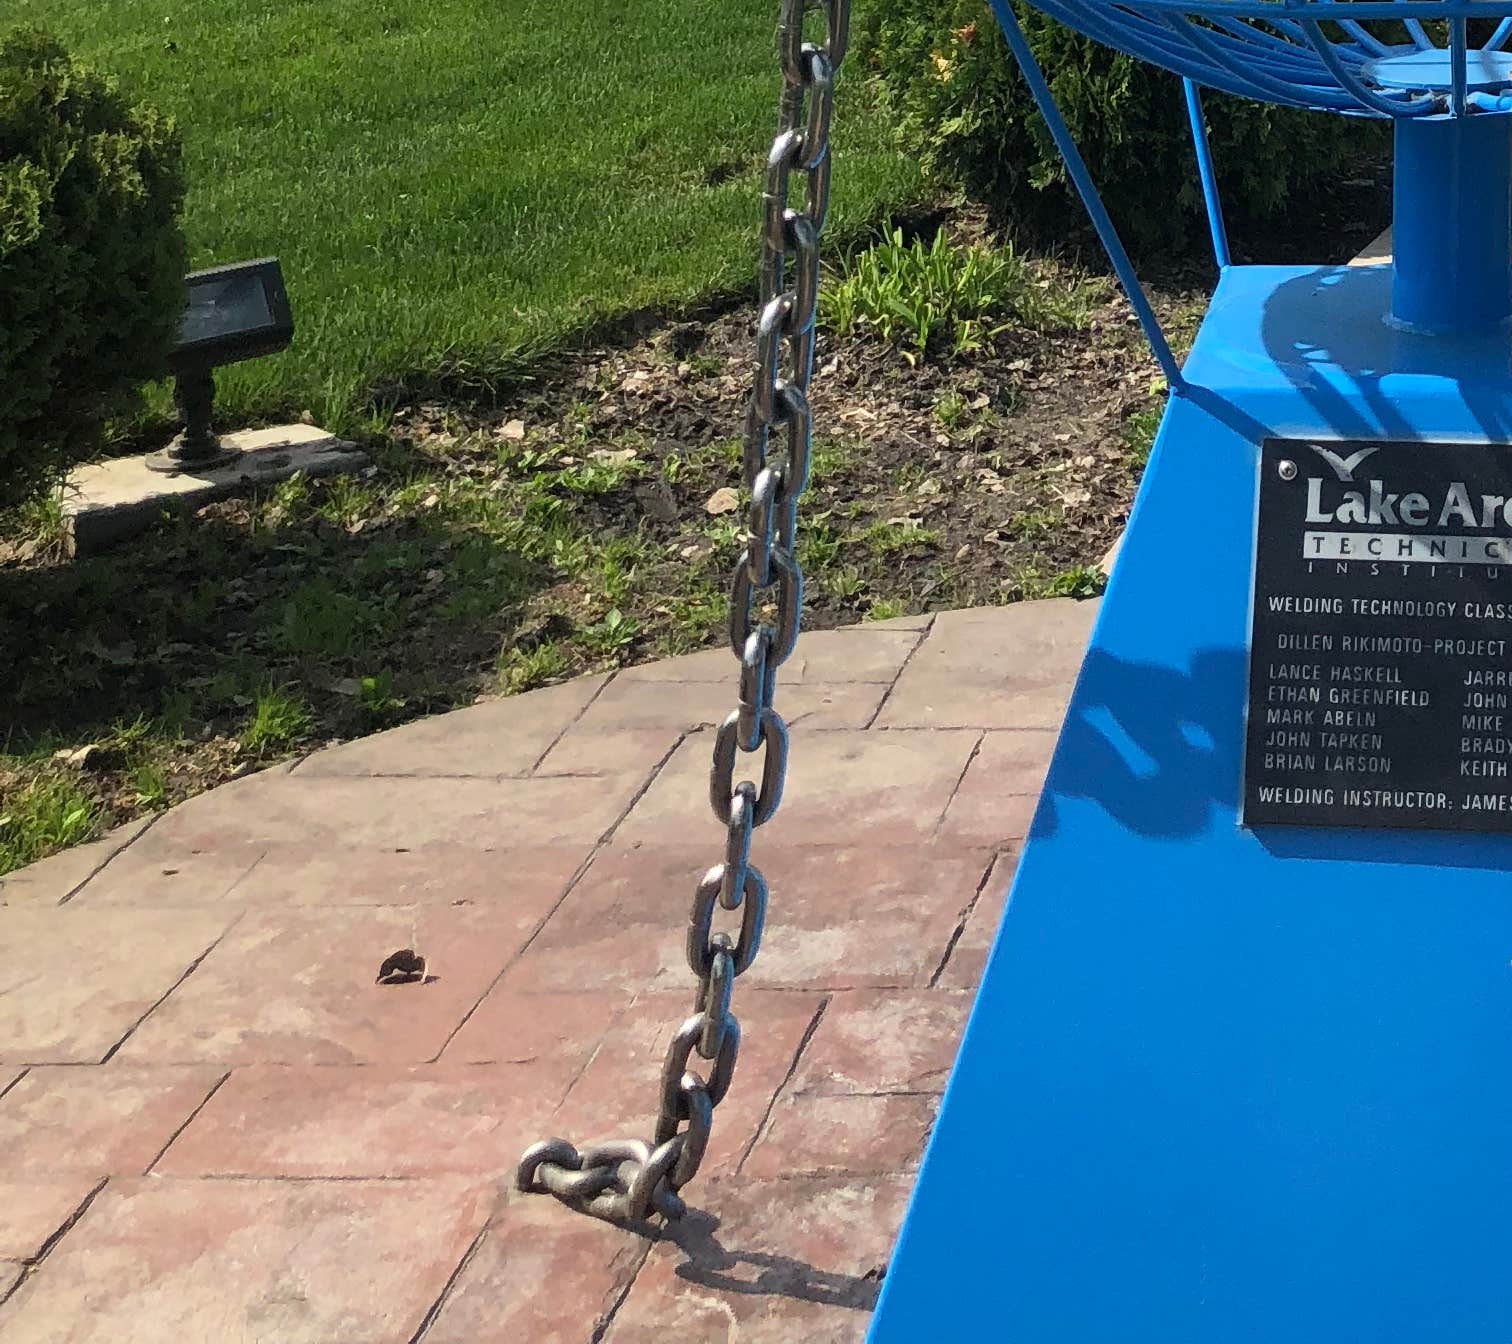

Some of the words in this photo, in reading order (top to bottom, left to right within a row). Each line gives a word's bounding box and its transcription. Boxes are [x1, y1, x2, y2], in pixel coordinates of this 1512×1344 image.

[1304, 477, 1430, 526] Lake
[1268, 596, 1343, 614] WELDING
[1351, 598, 1457, 618] TECHNOLOGY
[1277, 633, 1333, 651] DILLEN
[1269, 664, 1321, 681] LANCE
[1330, 666, 1403, 684] HASKELL
[1267, 685, 1321, 703] ETHAN
[1328, 687, 1430, 707] GREENFIELD
[1463, 692, 1508, 709] JOHN
[1266, 708, 1315, 725] MARK
[1322, 710, 1377, 728] ABELN
[1461, 714, 1504, 732] MIKE
[1265, 730, 1311, 748] JOHN
[1320, 731, 1384, 750] TAPKEN
[1264, 752, 1316, 771] BRIAN
[1324, 755, 1393, 774] LARSON
[1460, 759, 1508, 778] KEITH
[1258, 786, 1335, 806] WELDING
